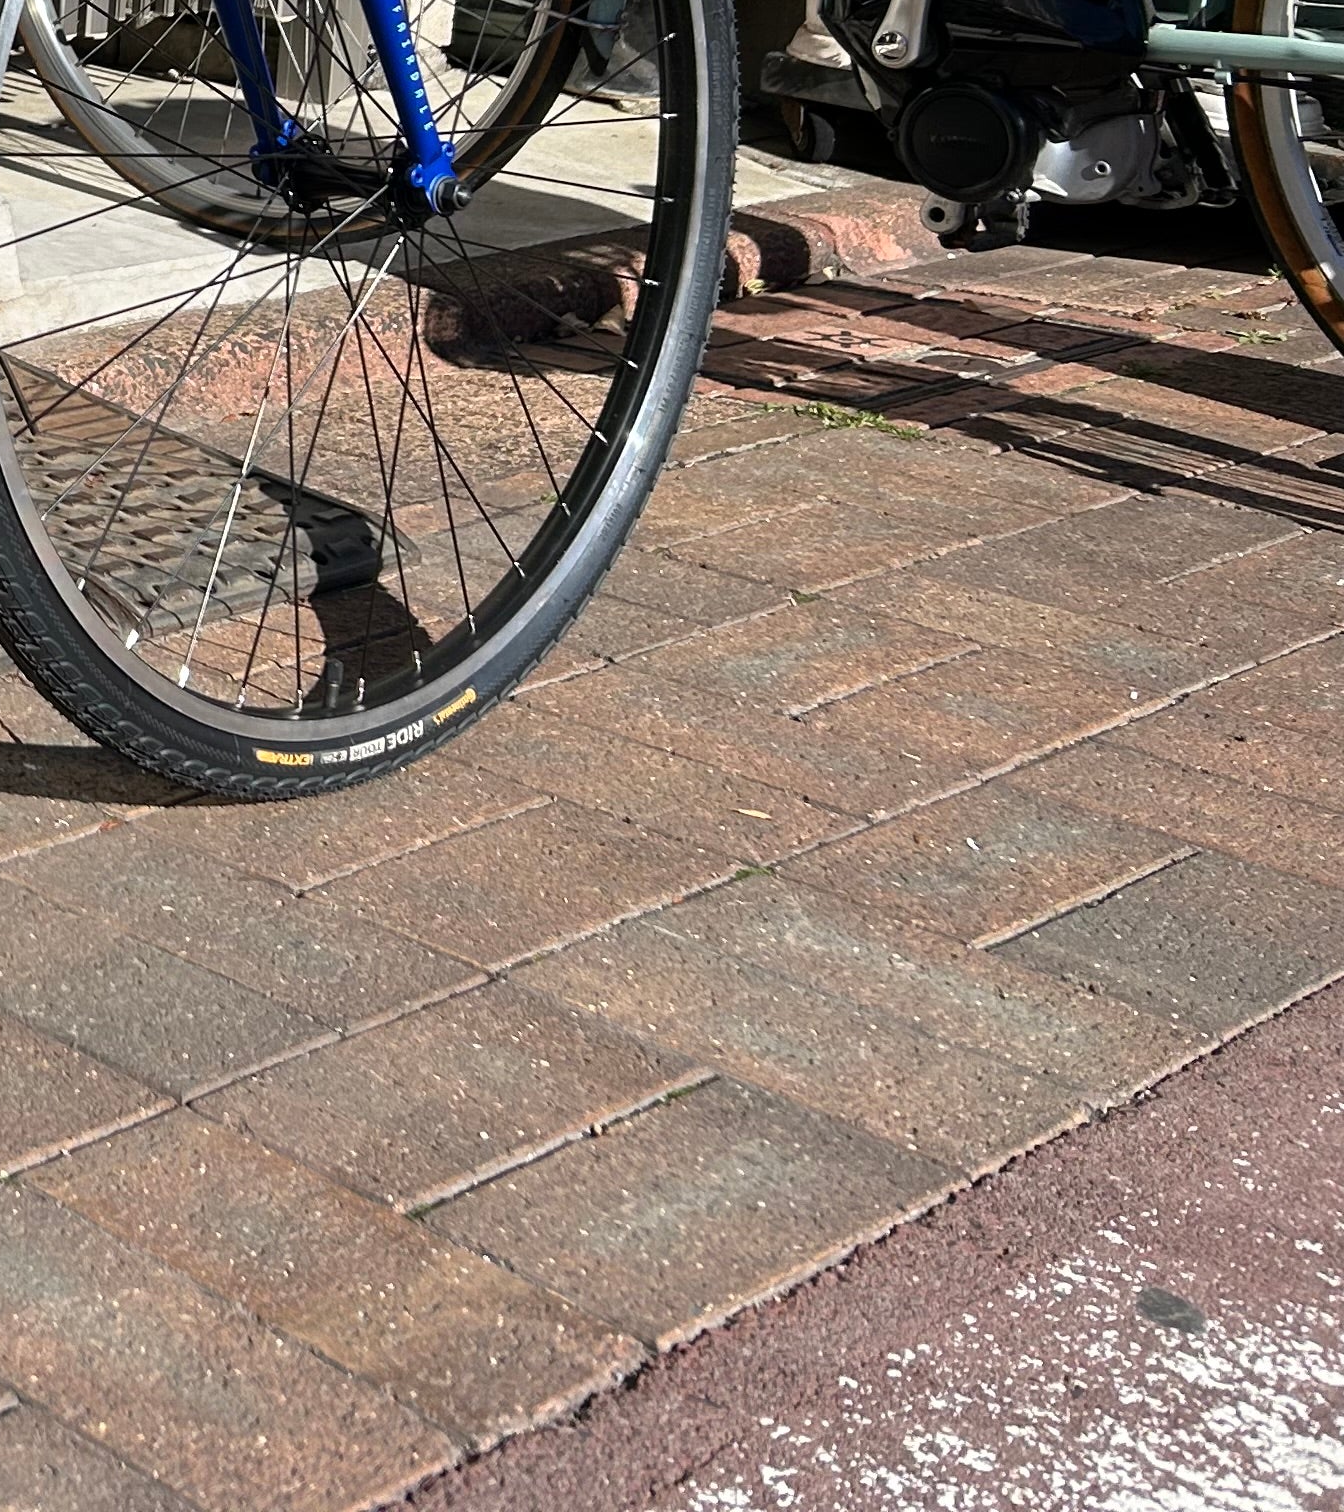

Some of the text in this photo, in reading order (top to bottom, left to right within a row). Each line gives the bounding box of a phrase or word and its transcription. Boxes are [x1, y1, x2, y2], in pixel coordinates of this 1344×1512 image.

[391, 2, 436, 133] FAIRDALE
[387, 719, 424, 750] RIDE
[271, 752, 311, 766] EXTRA
[351, 740, 384, 760] TOUR
